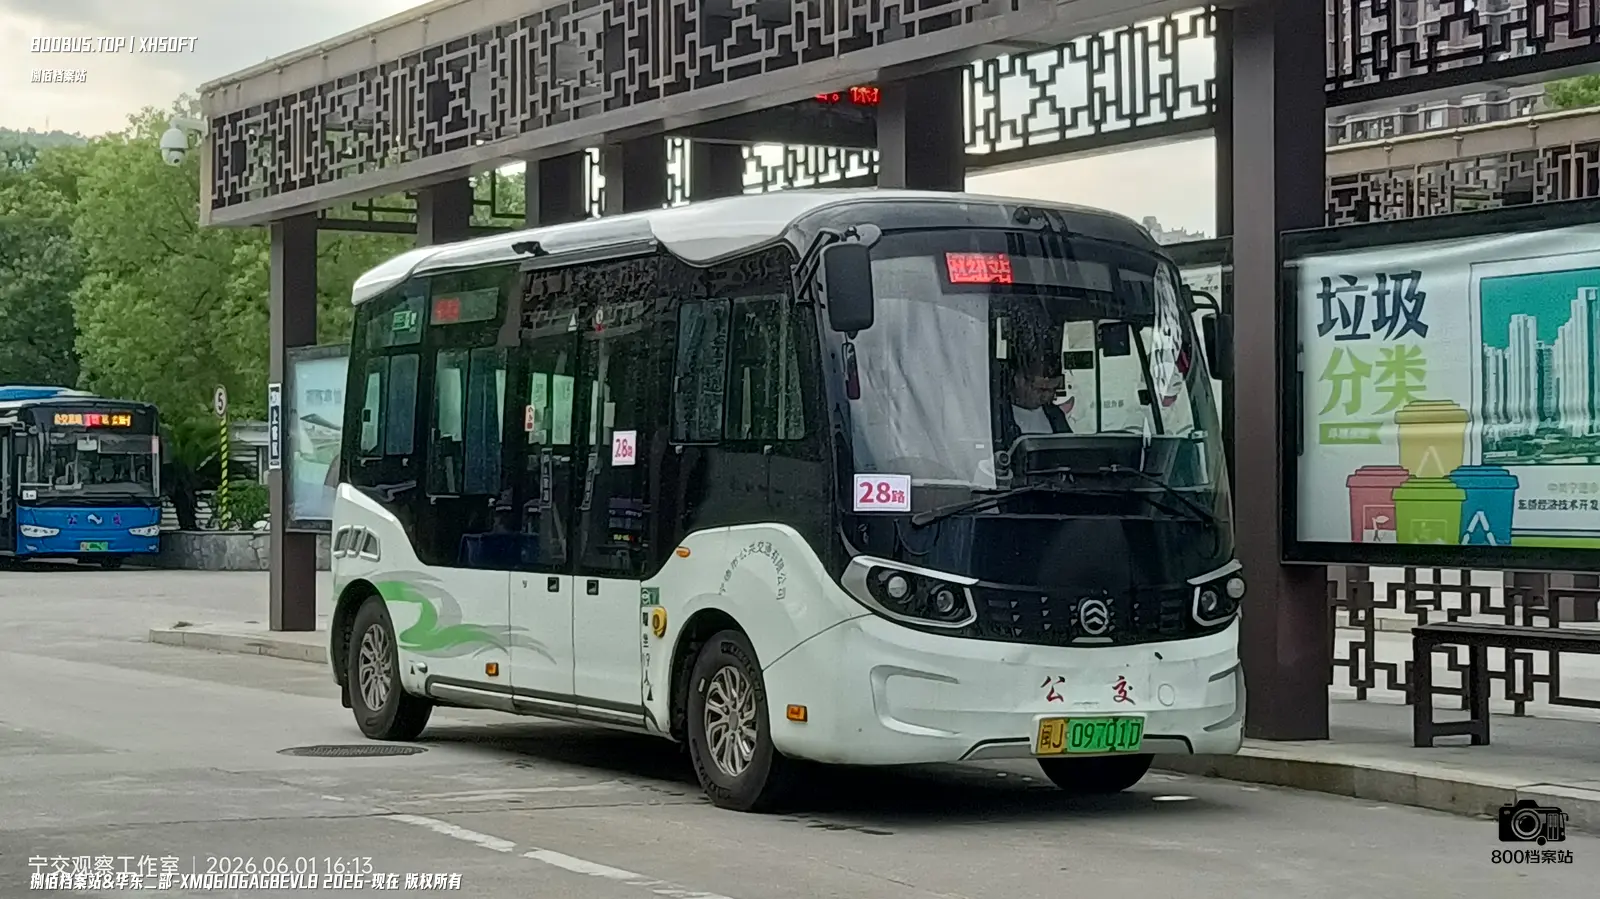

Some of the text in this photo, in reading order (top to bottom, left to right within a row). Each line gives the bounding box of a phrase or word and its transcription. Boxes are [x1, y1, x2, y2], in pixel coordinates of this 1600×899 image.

[1317, 270, 1429, 341] 垃圾
[1318, 344, 1427, 416] 分类
[217, 391, 223, 410] 5
[859, 481, 905, 504] 28路
[1040, 675, 1136, 705] 公 交
